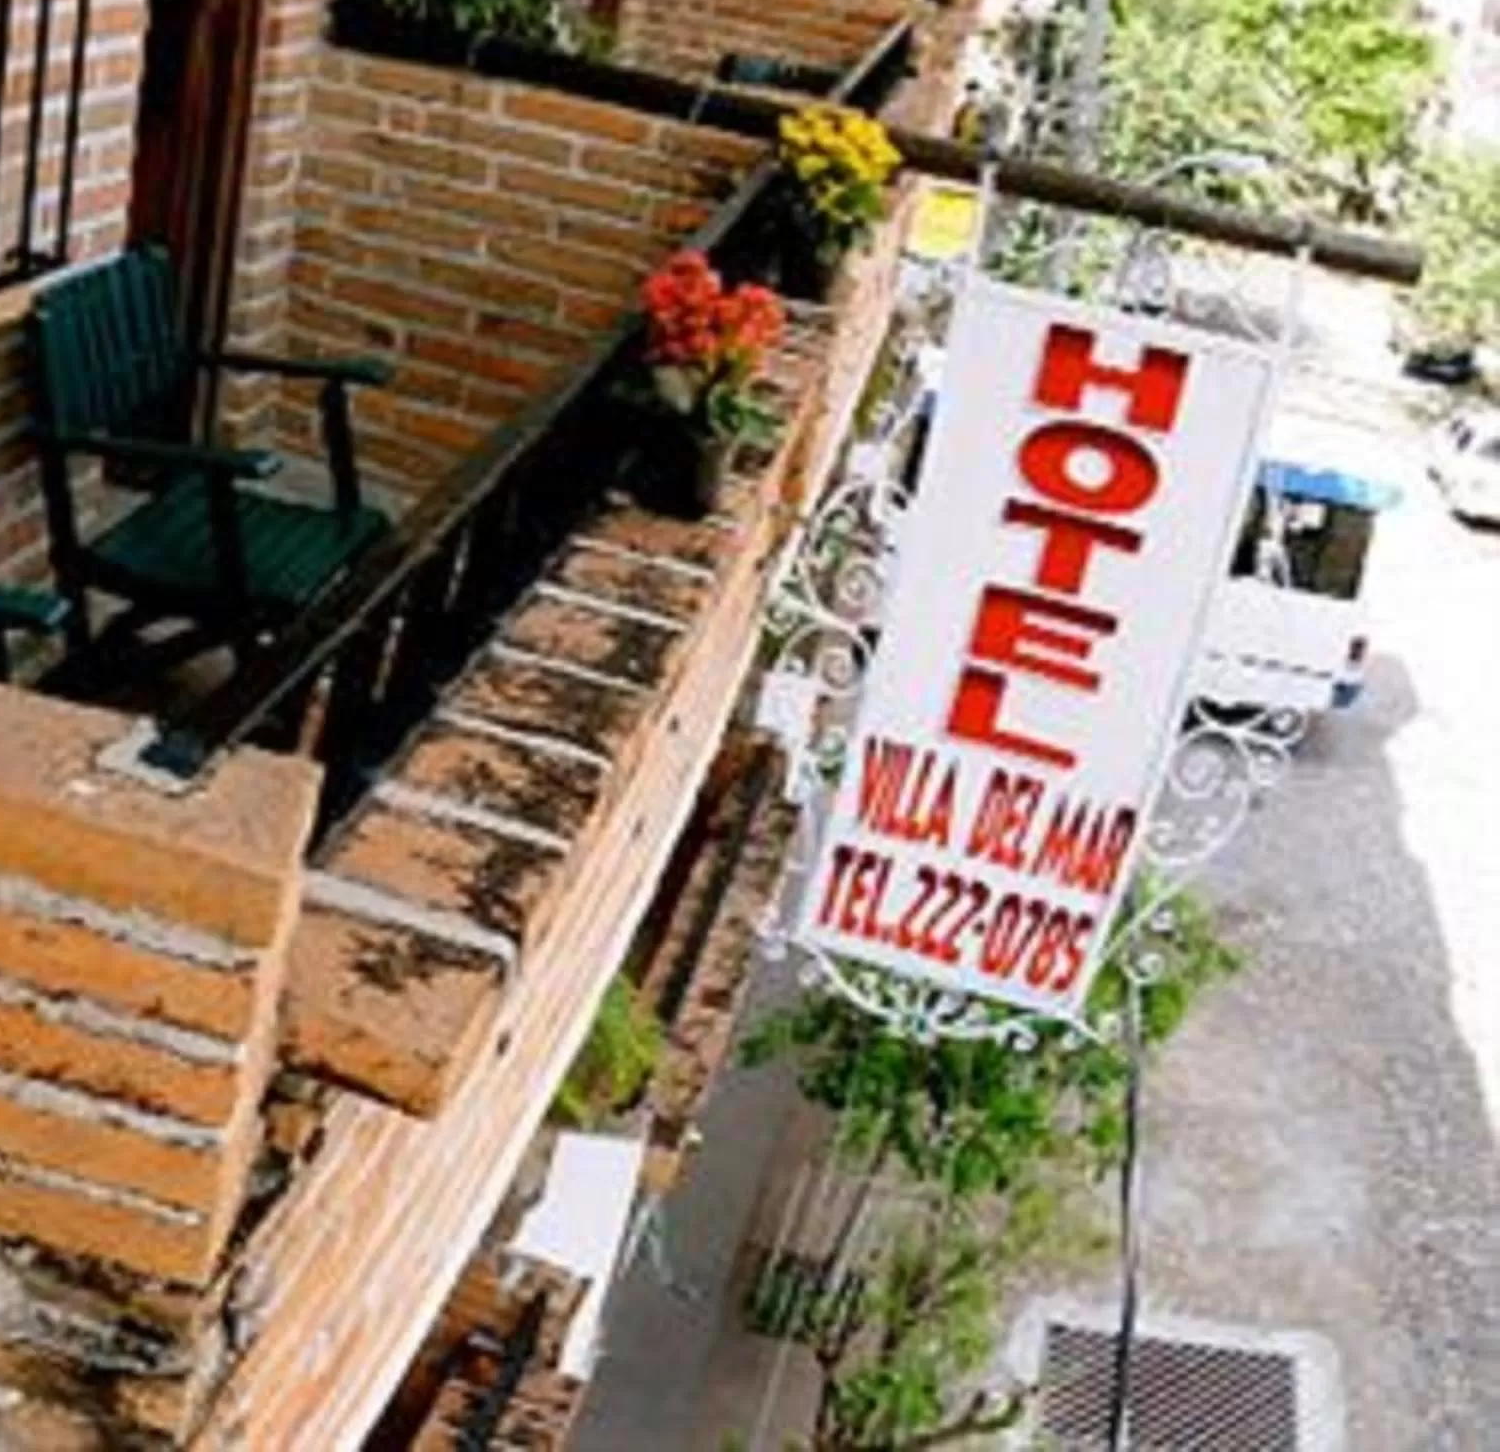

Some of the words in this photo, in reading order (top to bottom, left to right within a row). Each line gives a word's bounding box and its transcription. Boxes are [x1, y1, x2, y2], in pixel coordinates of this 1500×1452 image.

[948, 323, 1191, 768] HOTEL
[858, 738, 958, 849] VILLA
[967, 768, 1044, 868] DEL
[1031, 793, 1137, 895] MAR
